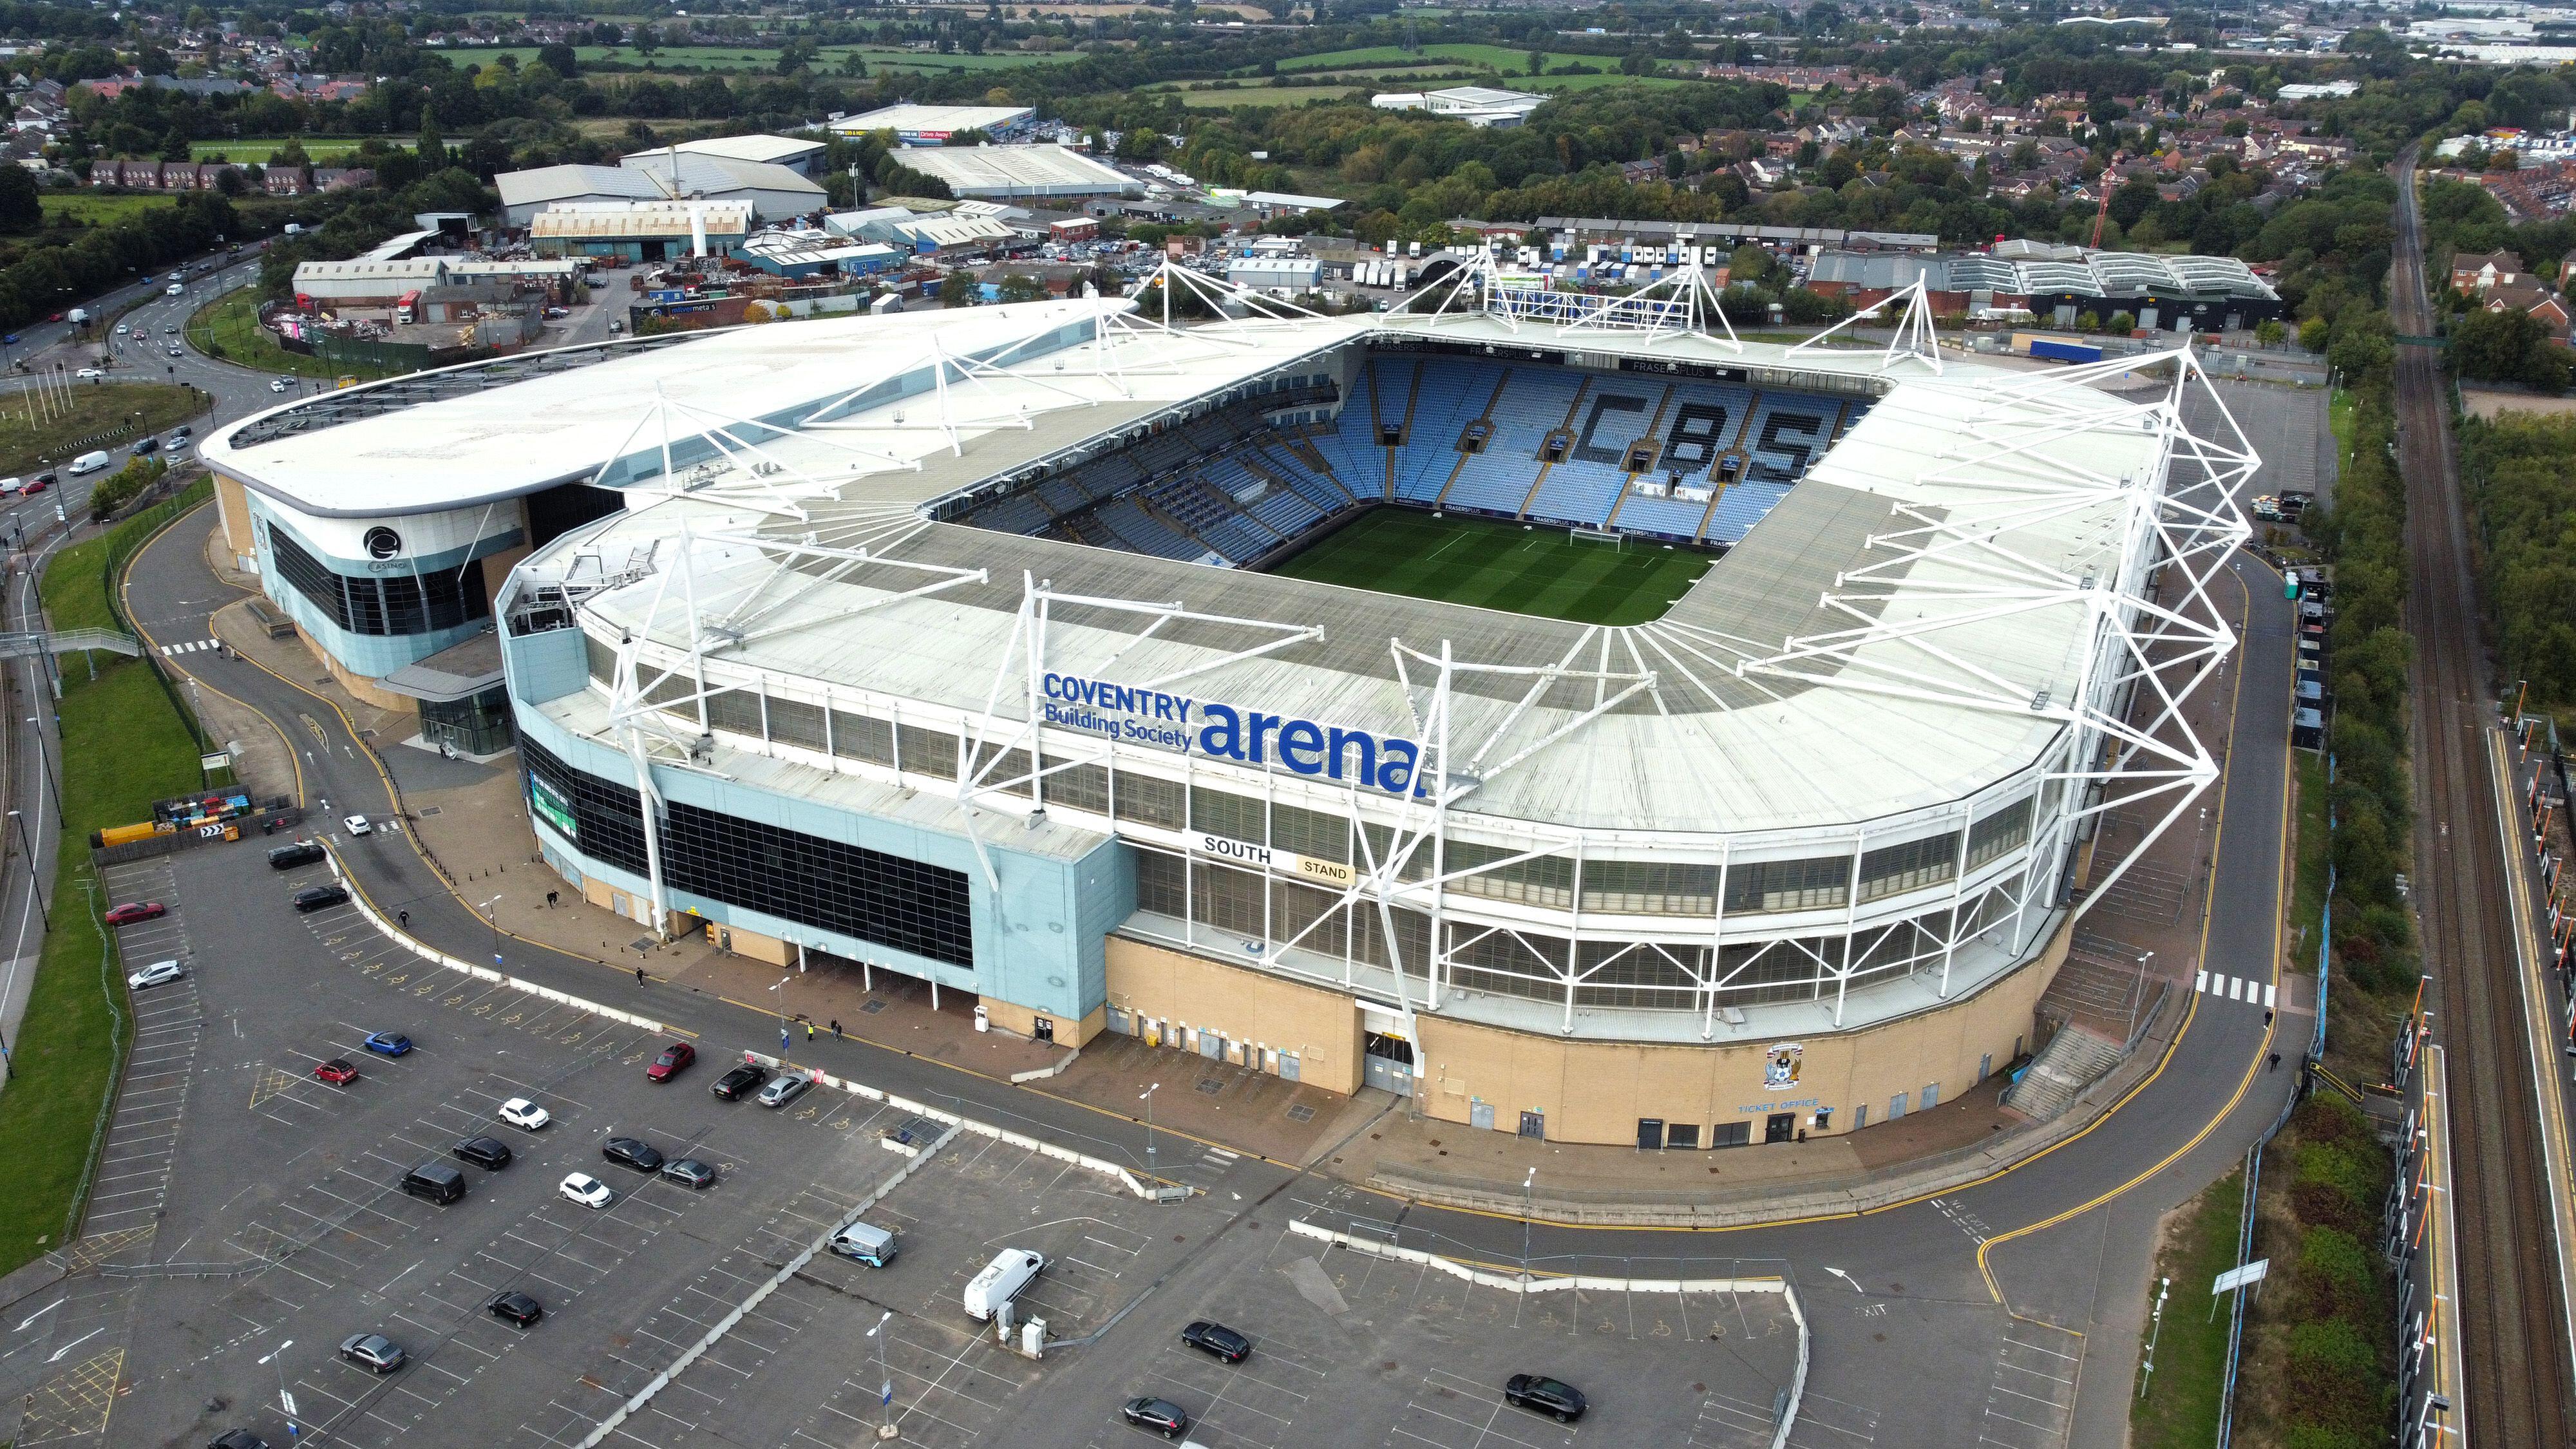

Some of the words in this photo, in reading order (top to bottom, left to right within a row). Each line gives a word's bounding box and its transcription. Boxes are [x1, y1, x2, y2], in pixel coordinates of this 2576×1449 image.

[1445, 504, 1481, 515] FRASERSPLUS
[1533, 516, 1569, 526] FRASERSPLUS
[1619, 527, 1658, 538] FRASERSPLUS
[368, 561, 406, 572] CASINO
[1043, 672, 1192, 724] COVENTRY
[1045, 703, 1120, 739] Building
[1124, 718, 1193, 752] Society
[1200, 703, 1426, 798] arena
[1204, 835, 1273, 865] SOUTH
[1304, 860, 1347, 880] STAND
[1738, 1102, 1776, 1114] TICKET
[1780, 1098, 1819, 1110] OFFICE
